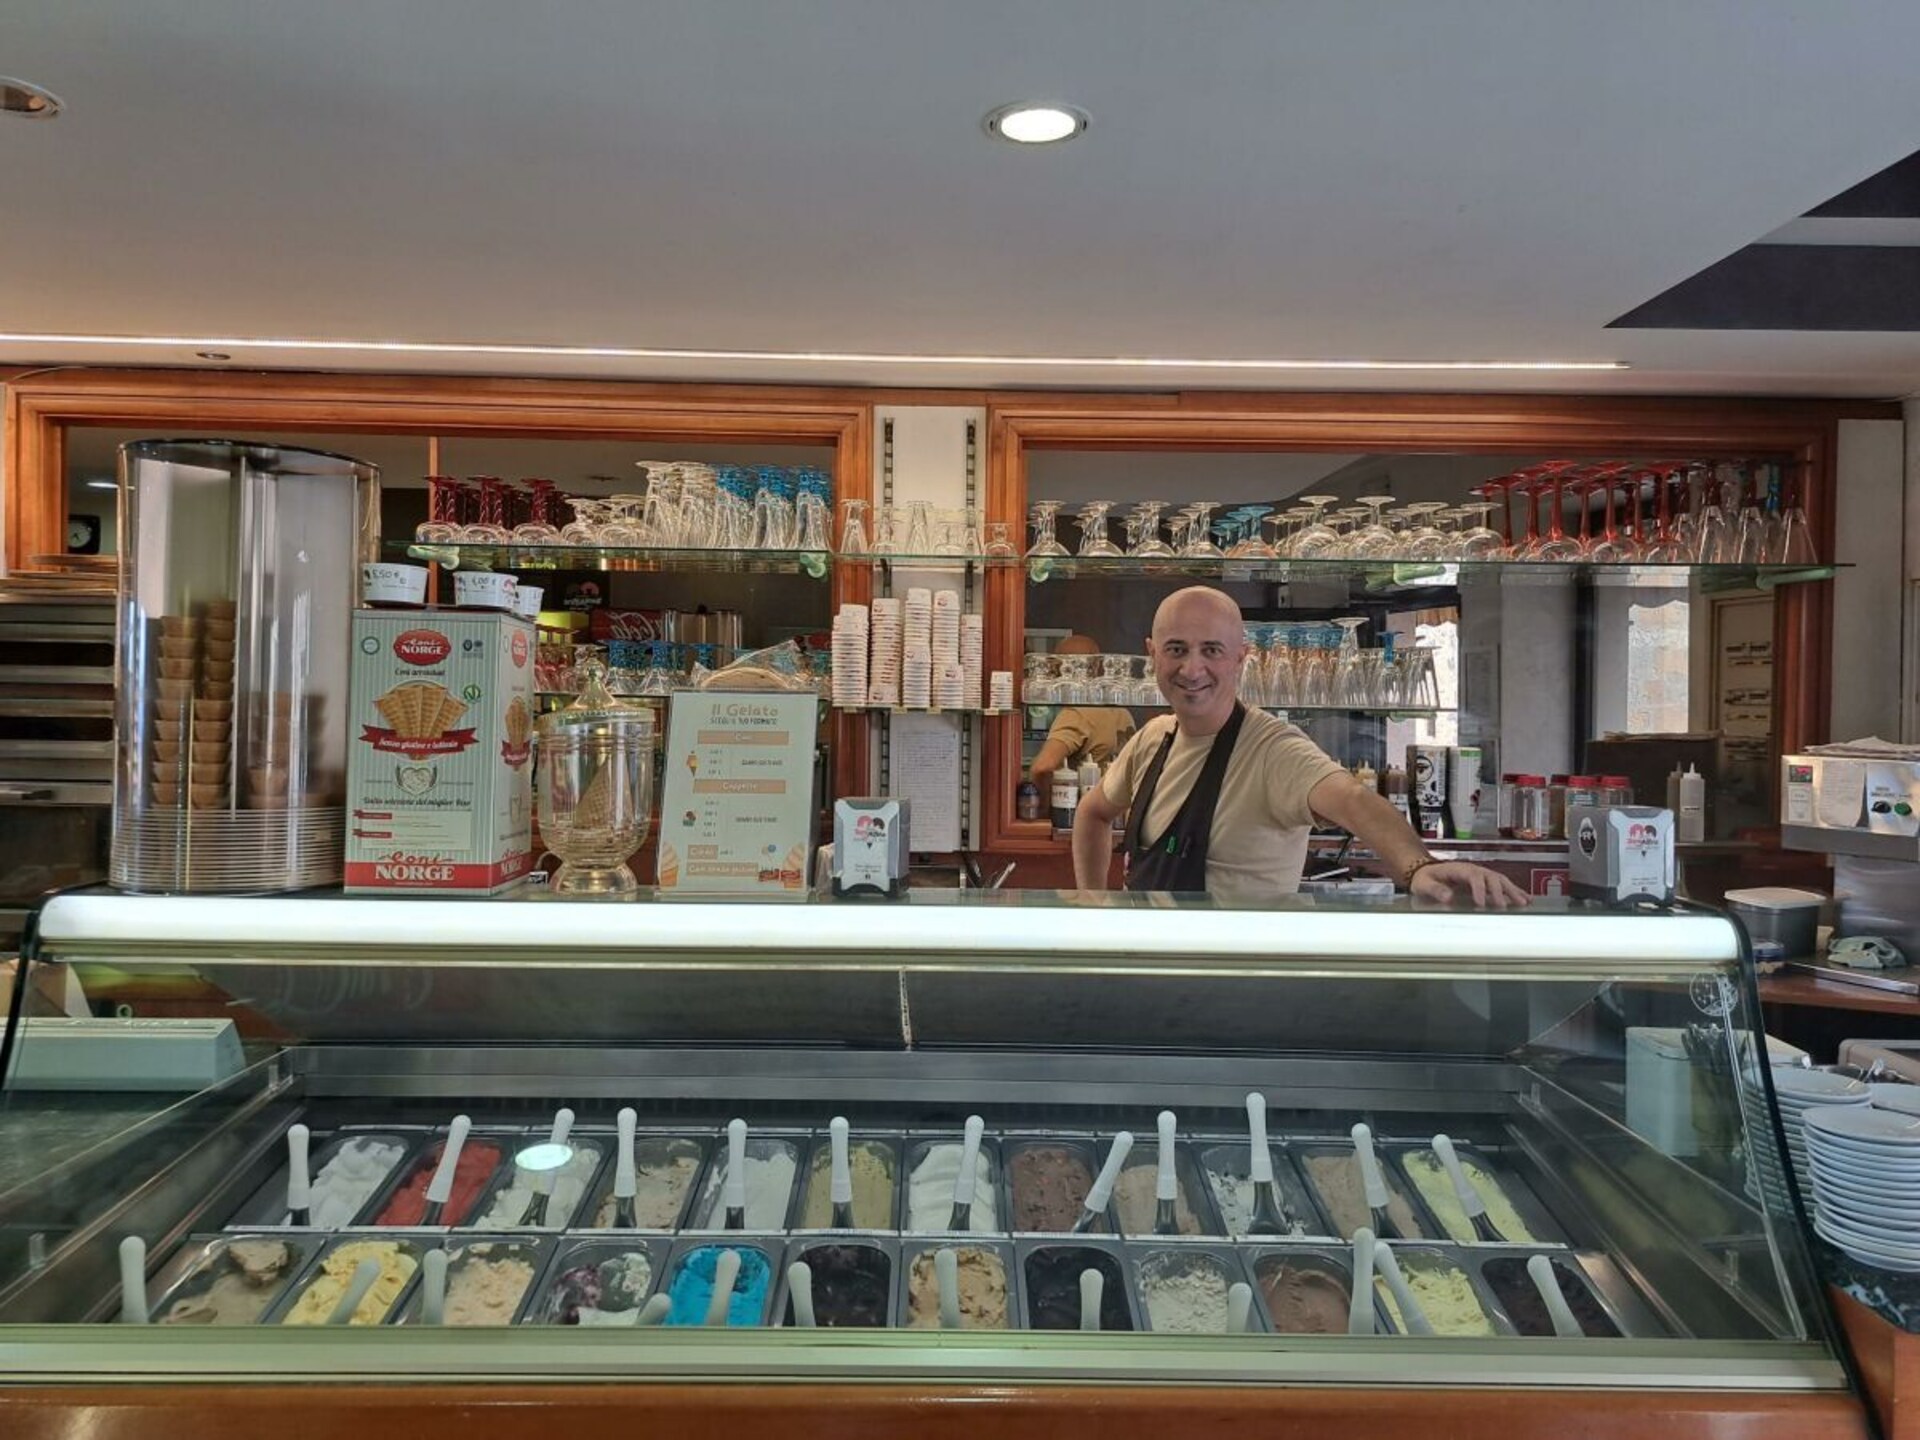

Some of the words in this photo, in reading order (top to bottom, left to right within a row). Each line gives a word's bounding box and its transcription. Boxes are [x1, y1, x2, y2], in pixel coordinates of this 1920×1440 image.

[402, 645, 443, 655] NORGE
[712, 704, 721, 716] Il
[726, 704, 779, 717] Gelato
[375, 865, 455, 881] NORGE
